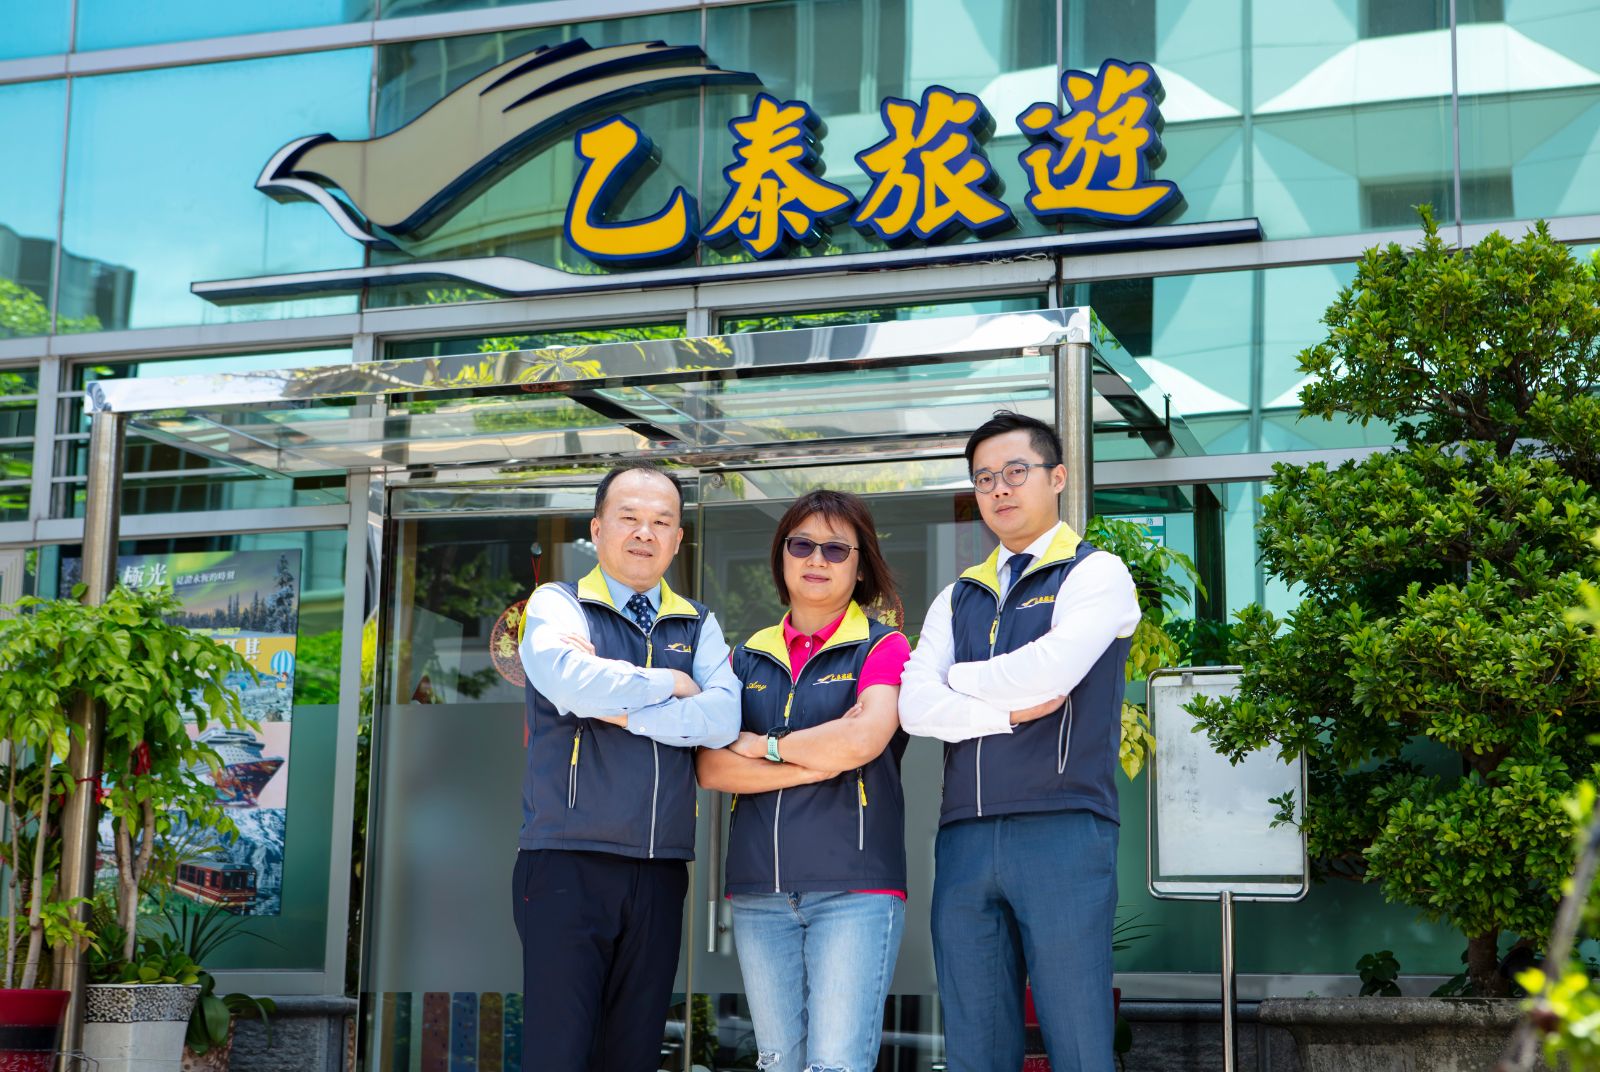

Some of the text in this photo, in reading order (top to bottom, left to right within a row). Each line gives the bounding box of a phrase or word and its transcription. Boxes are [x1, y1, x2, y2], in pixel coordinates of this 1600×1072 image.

[564, 58, 1184, 263] 乙泰旅遊
[123, 562, 167, 588] 極光
